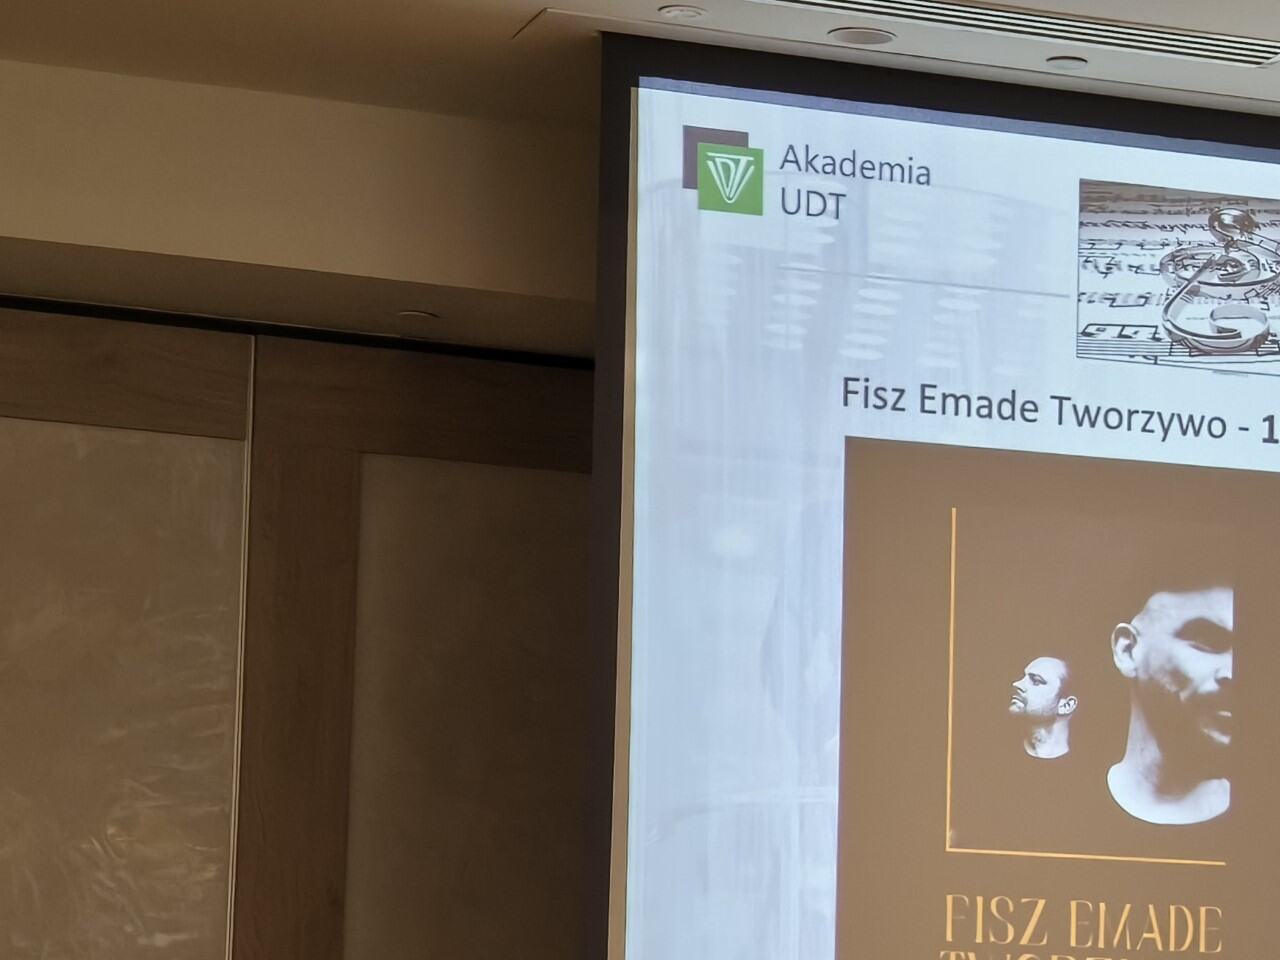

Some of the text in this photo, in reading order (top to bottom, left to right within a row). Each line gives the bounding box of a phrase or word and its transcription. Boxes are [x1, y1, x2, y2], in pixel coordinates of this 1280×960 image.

[779, 144, 931, 186] Akademia
[781, 187, 847, 219] UDT
[842, 376, 907, 412] Fisz
[918, 384, 1039, 423] Emade
[1050, 395, 1227, 442] Tworzywo
[945, 894, 1223, 953] FISZ EMADE
